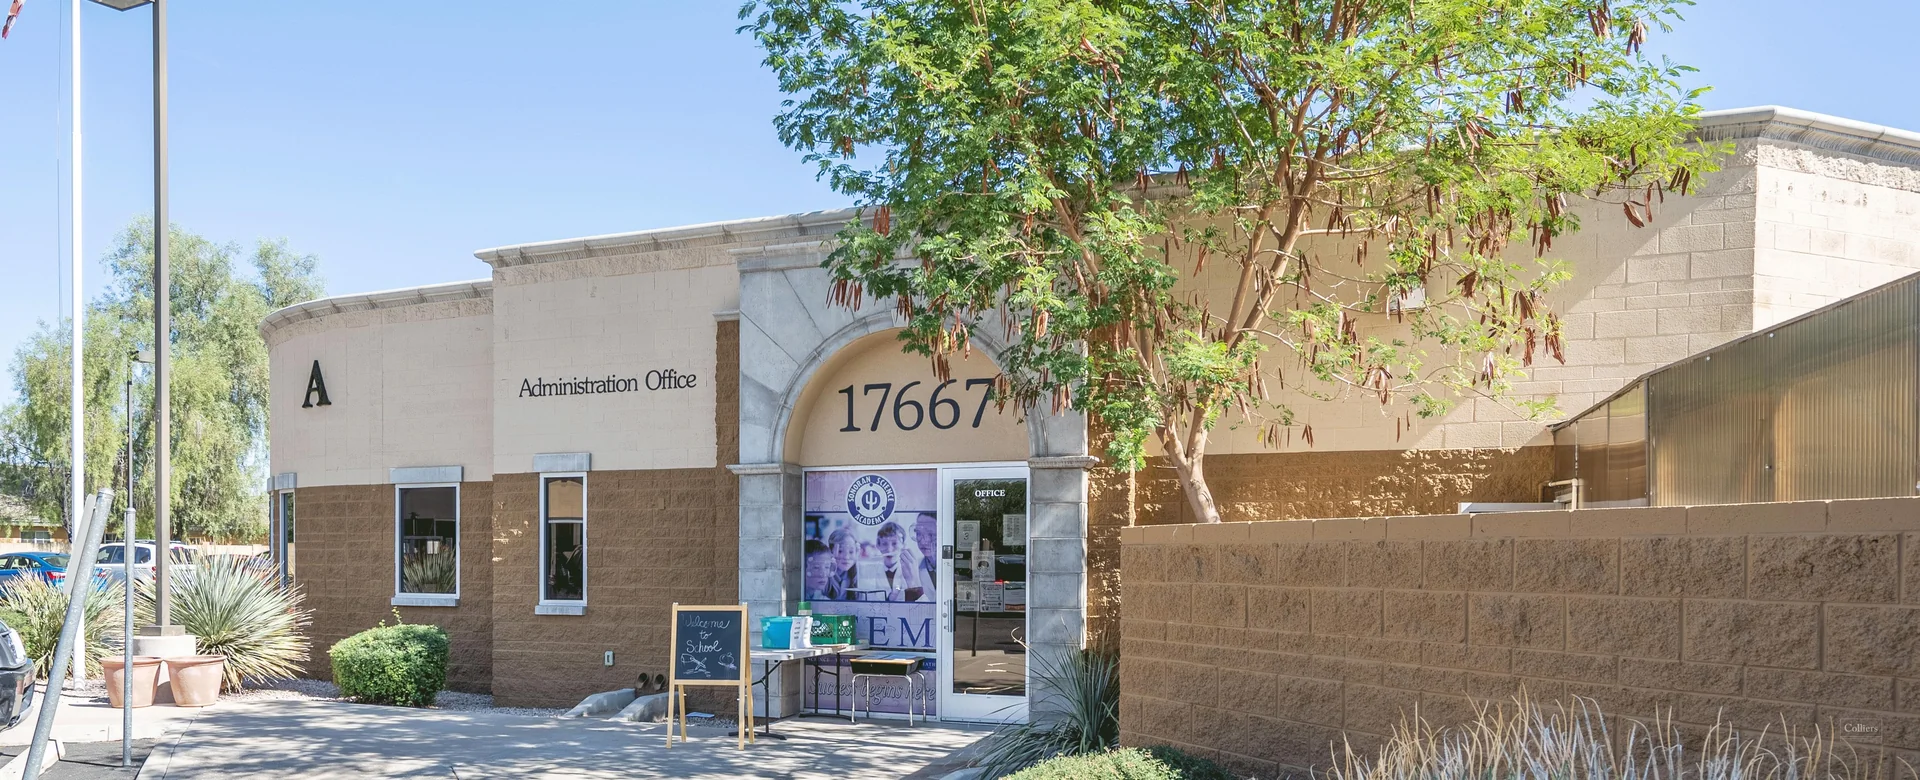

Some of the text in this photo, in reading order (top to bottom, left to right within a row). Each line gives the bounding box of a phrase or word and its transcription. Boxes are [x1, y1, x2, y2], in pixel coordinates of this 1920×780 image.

[302, 359, 332, 408] A
[518, 369, 697, 398] Administration Office
[838, 378, 997, 432] 17667
[848, 476, 894, 502] SONORAN SCIENCE
[975, 489, 1006, 497] OFFICE
[855, 513, 885, 525] ACADEMY
[682, 614, 730, 629] Welcome
[700, 631, 712, 640] to
[686, 640, 722, 653] School
